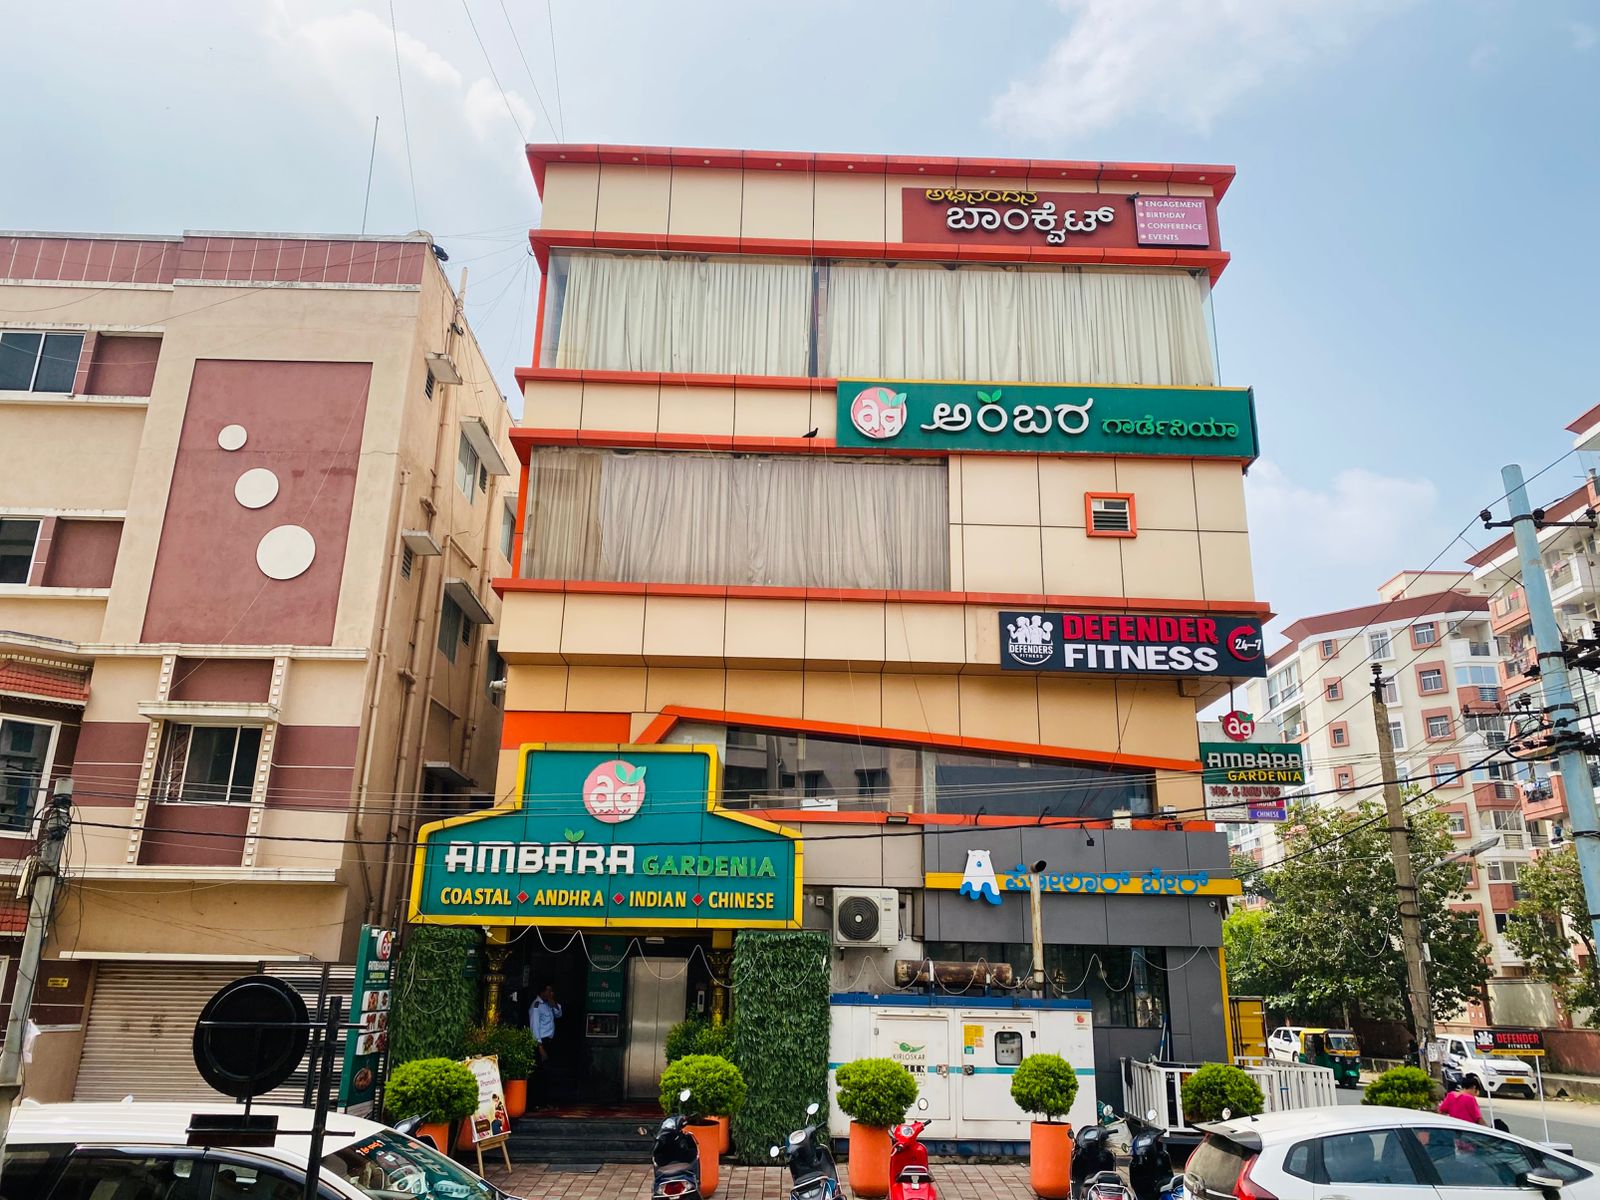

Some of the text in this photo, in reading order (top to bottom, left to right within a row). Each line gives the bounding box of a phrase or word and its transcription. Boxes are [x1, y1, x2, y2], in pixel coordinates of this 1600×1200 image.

[925, 188, 1039, 206] ಅಭಿನಂದನ
[1146, 211, 1186, 219] BIRTHDAY
[1147, 222, 1204, 230] CONFERENCE
[1148, 233, 1179, 241] EVENTS
[920, 397, 1094, 435] ಅಂಬರ
[1062, 615, 1219, 645] DEFENDER
[1009, 644, 1053, 655] DEFENDERS
[1064, 643, 1219, 672] FITNESS
[1206, 752, 1301, 769] AMBARA
[1228, 770, 1303, 782] GARDENIA
[1256, 809, 1280, 818] CHINESE
[444, 840, 776, 878] AMBARA GARDENIA
[440, 887, 775, 910] COASTAL ANDHRA INDIAN CHINESE
[1495, 1033, 1540, 1043] DEFENDER
